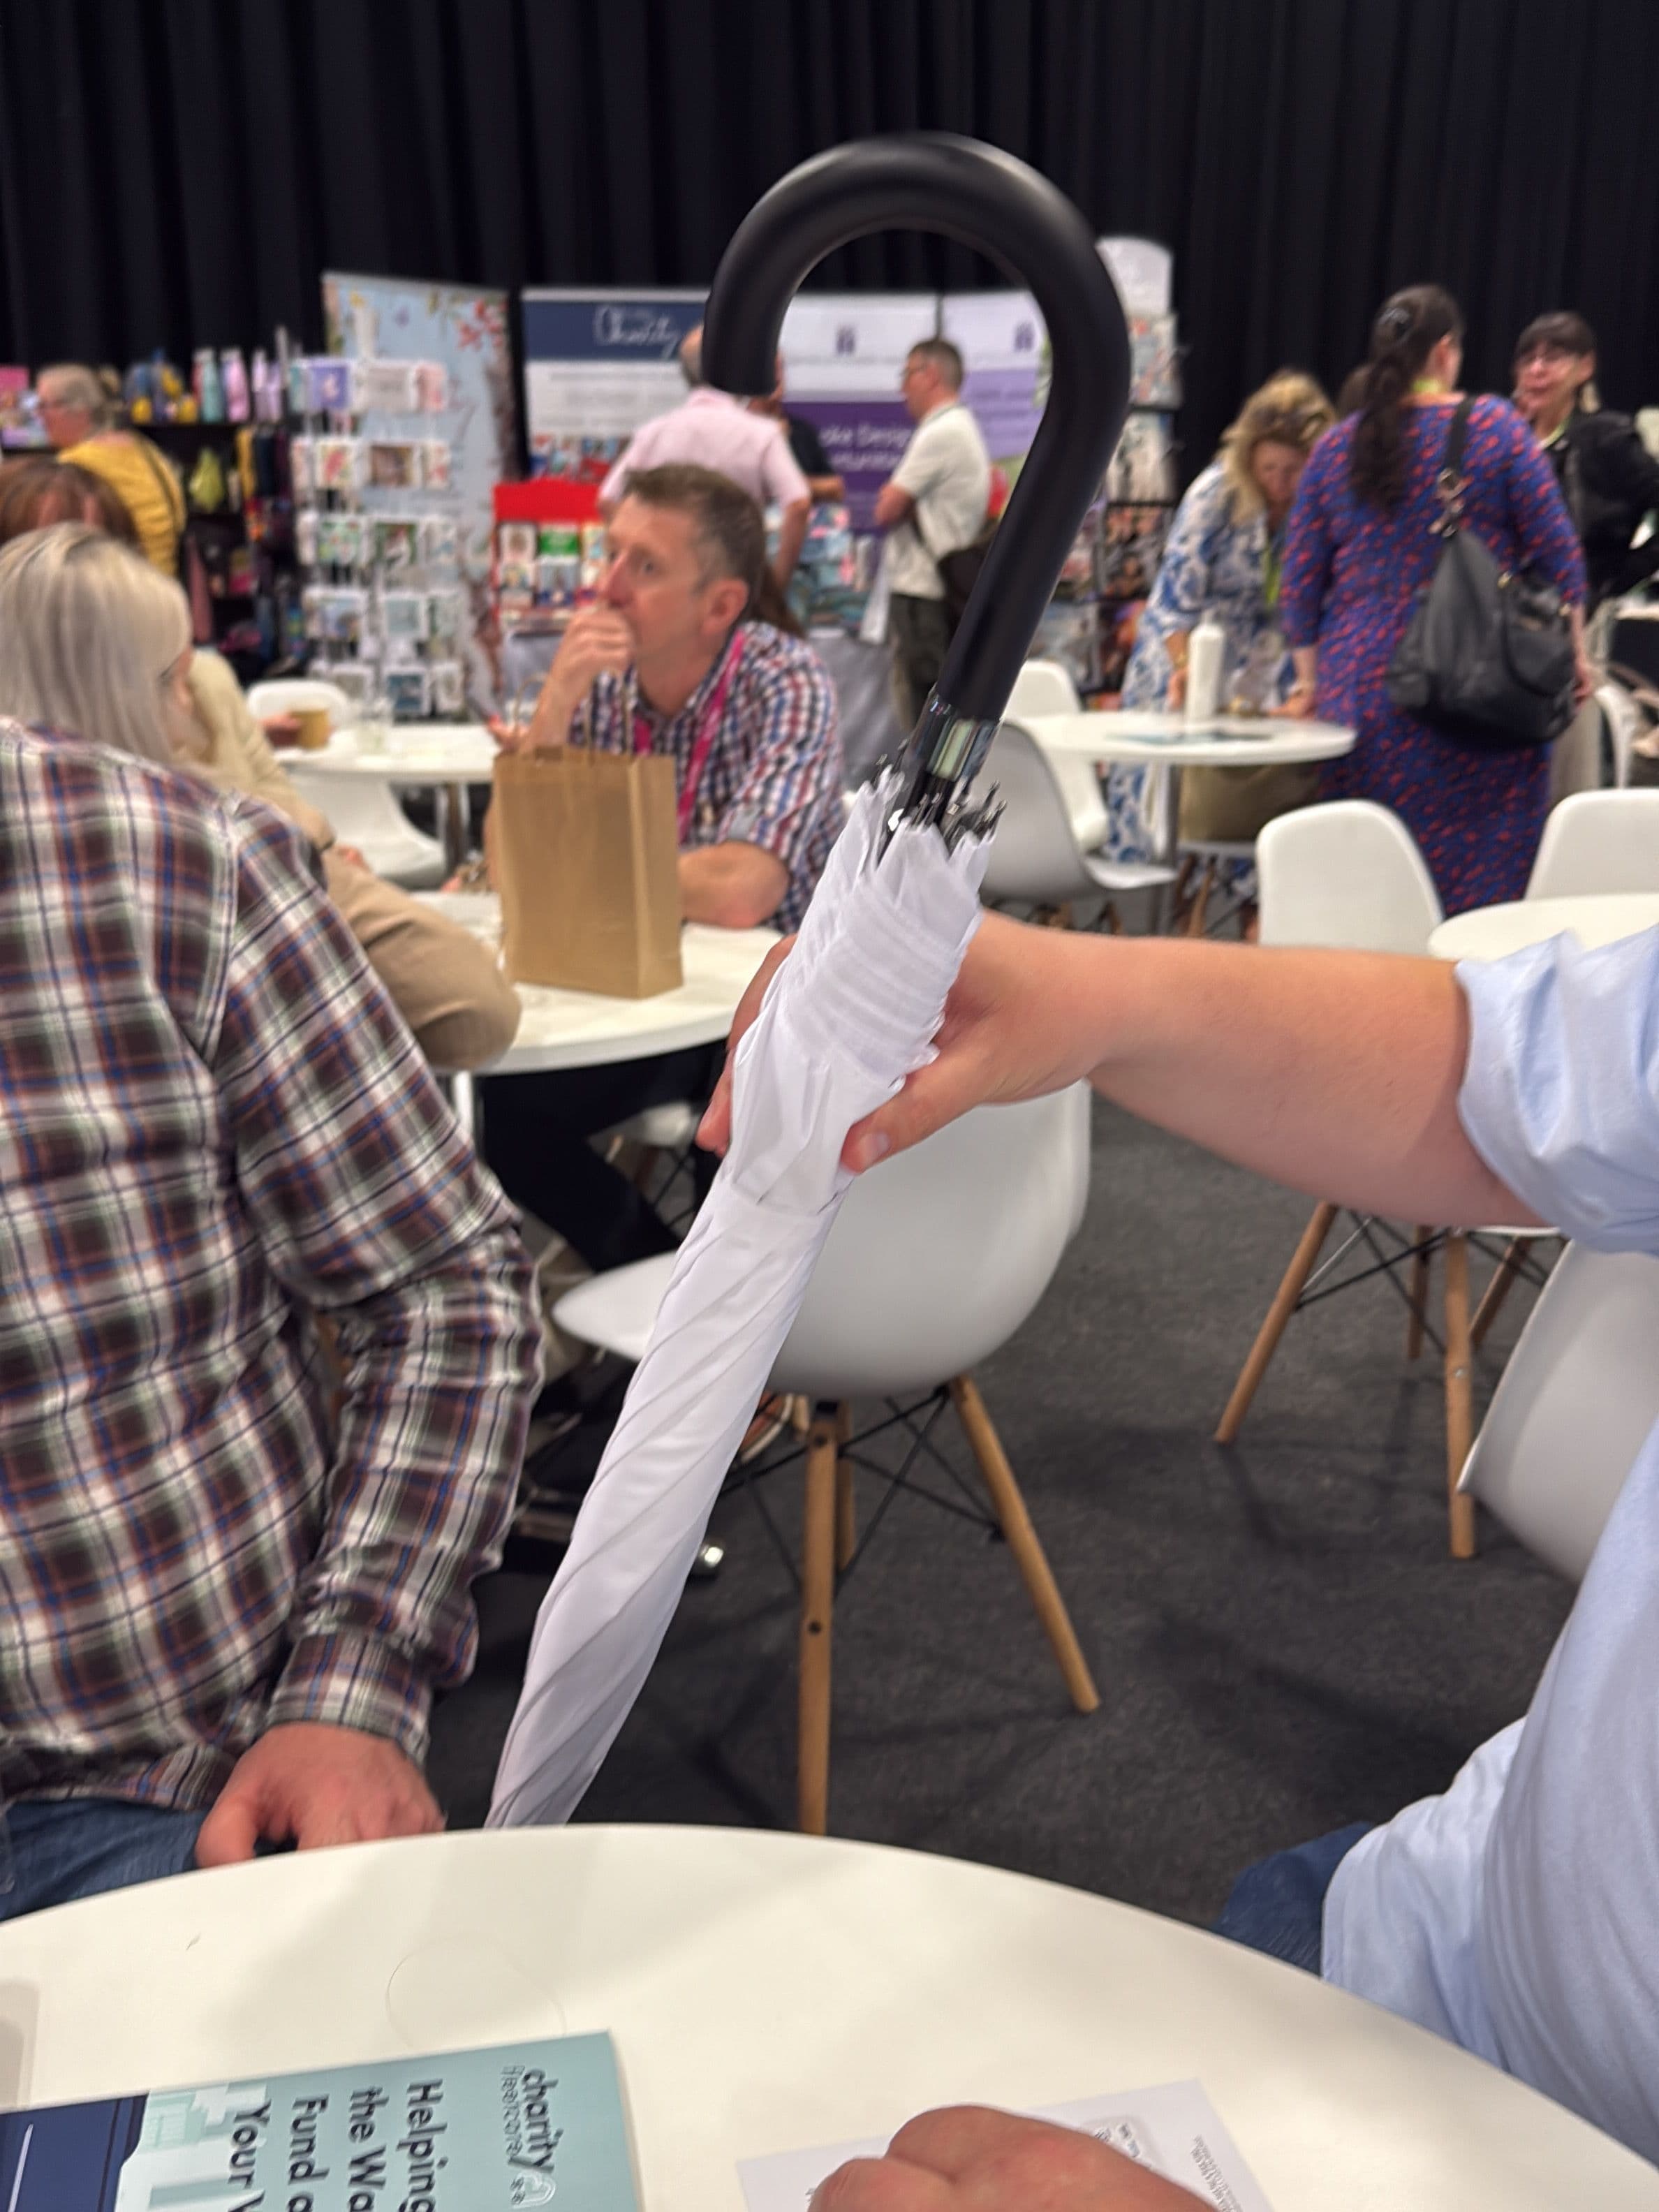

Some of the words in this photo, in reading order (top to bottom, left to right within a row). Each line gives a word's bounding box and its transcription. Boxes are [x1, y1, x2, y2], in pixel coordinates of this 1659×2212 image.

[228, 2097, 272, 2188] Your
[287, 2094, 330, 2185] Fund
[348, 2086, 390, 2144] the
[396, 2078, 449, 2212] Helping
[507, 2068, 563, 2173] charity
